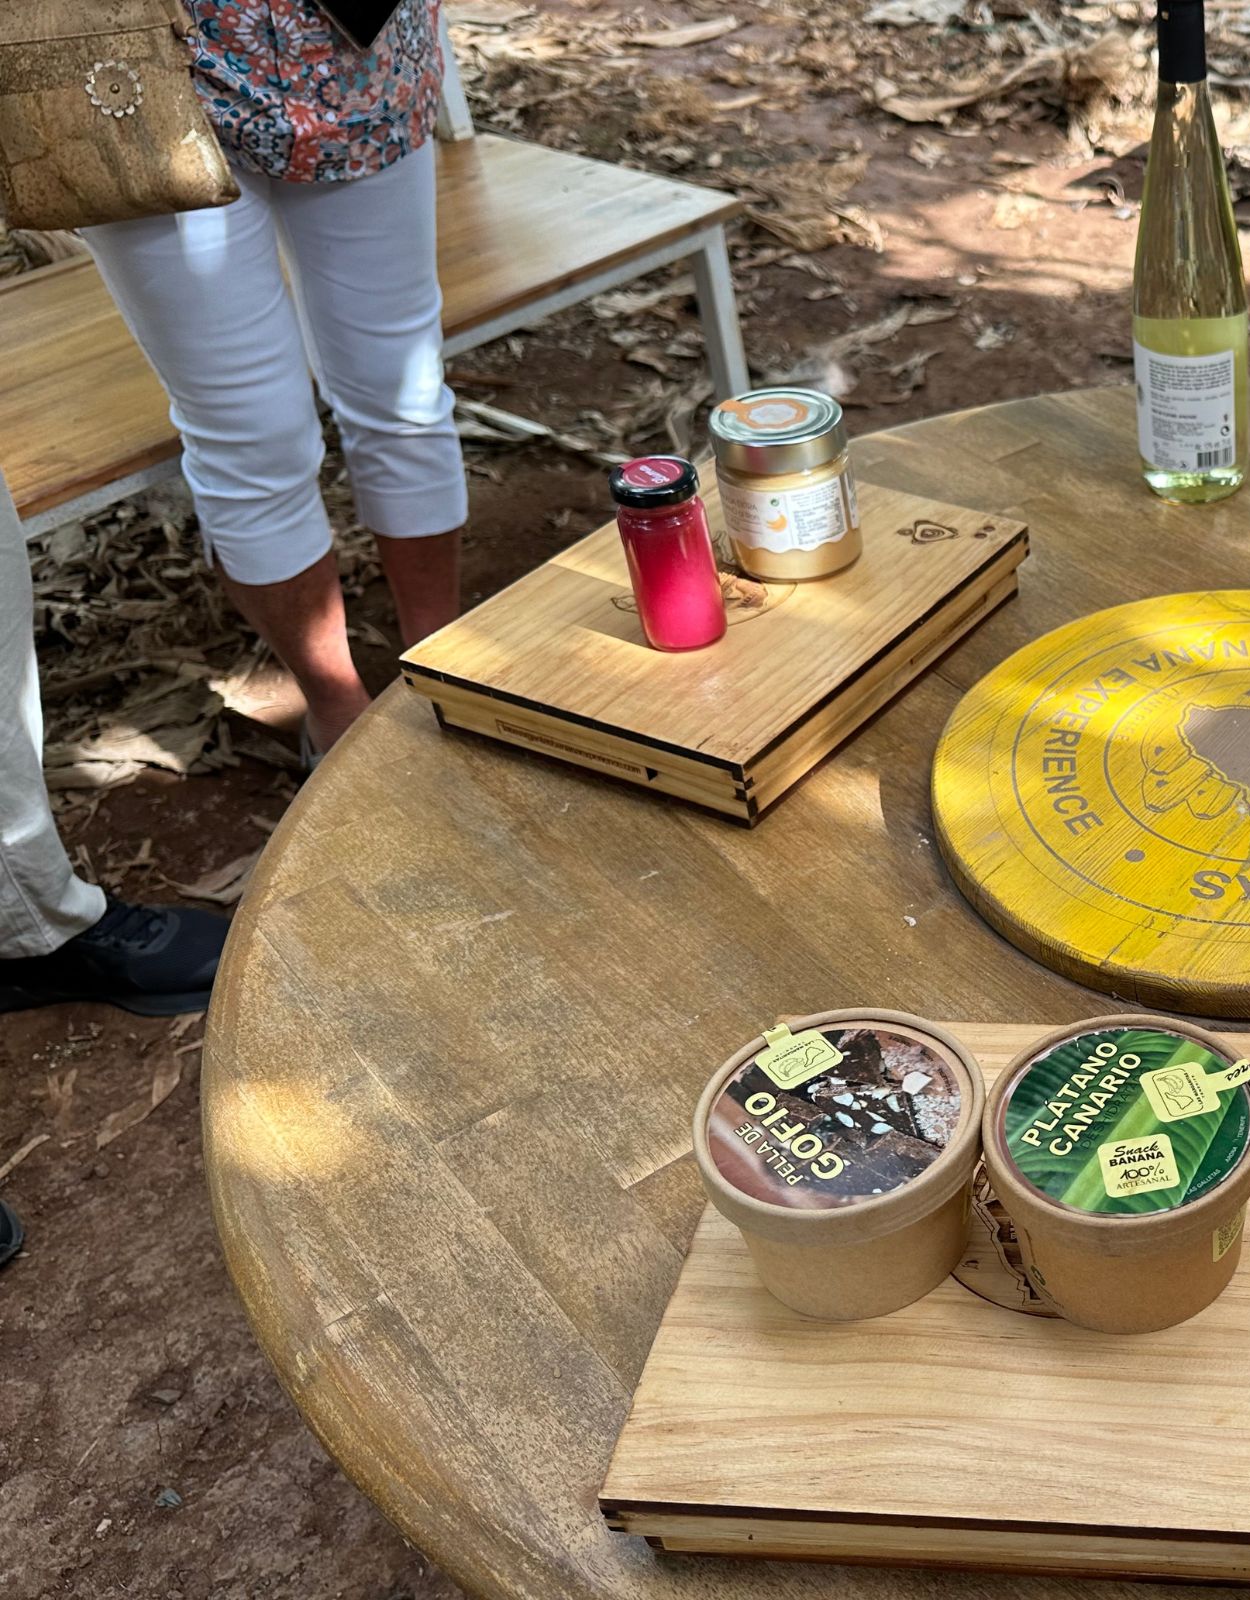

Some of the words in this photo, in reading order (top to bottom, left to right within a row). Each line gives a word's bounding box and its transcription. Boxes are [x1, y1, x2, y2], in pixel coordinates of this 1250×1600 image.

[1042, 667, 1137, 836] EXPERIENCE
[1021, 1042, 1118, 1147] PLÁTANO
[1049, 1053, 1141, 1156] CANARIO
[734, 1122, 762, 1145] DE
[744, 1091, 845, 1180] GOFIO
[756, 1140, 804, 1186] PELLA
[1109, 1151, 1165, 1167] BANANA
[1113, 1141, 1160, 1158] Snack
[1116, 1175, 1173, 1190] ARTESANAL
[1120, 1161, 1165, 1180] 100%
[1186, 1185, 1198, 1196] LAS
[1197, 1168, 1221, 1187] GALLETAS
